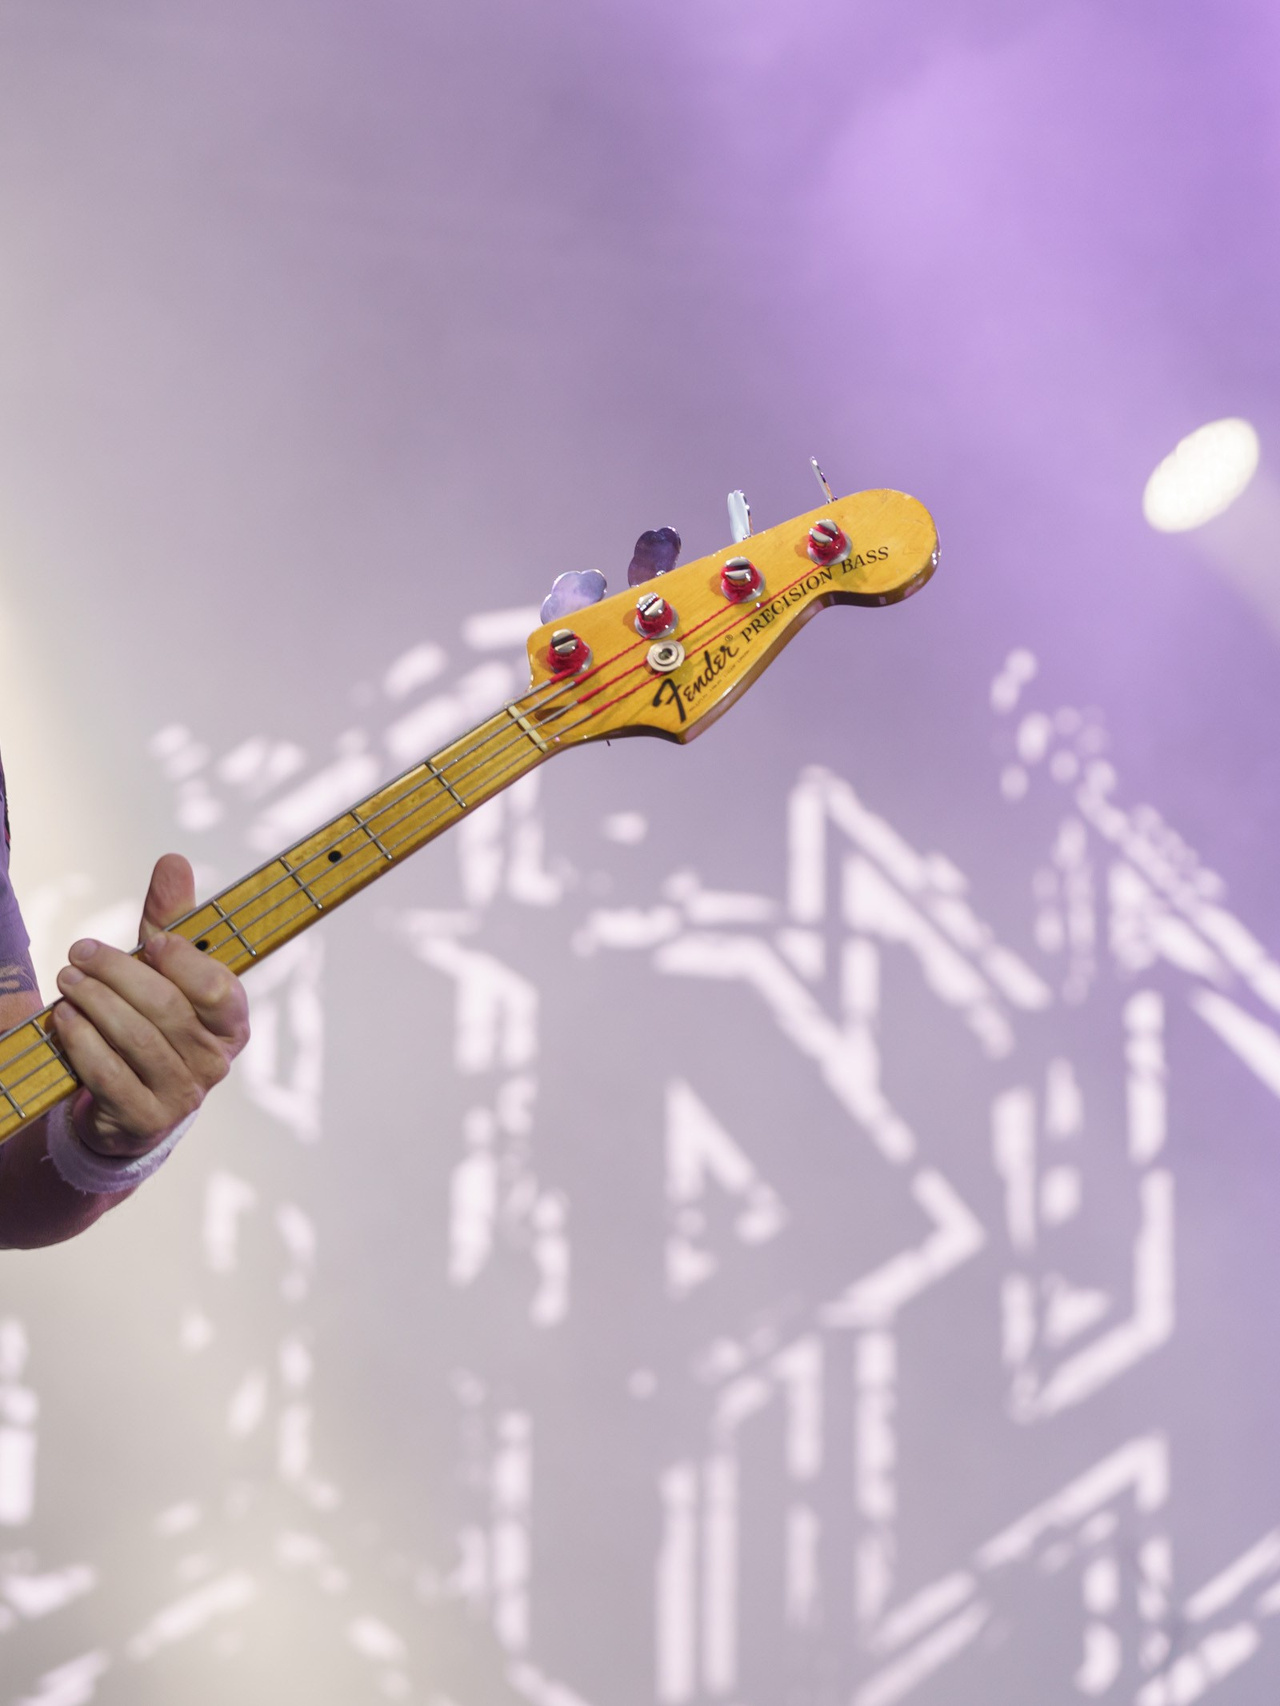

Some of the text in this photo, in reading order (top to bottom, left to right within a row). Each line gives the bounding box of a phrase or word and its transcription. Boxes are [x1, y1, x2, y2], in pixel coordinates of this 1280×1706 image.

[652, 642, 739, 723] Fender
[741, 566, 834, 642] PRECISION
[841, 546, 889, 575] BASS
